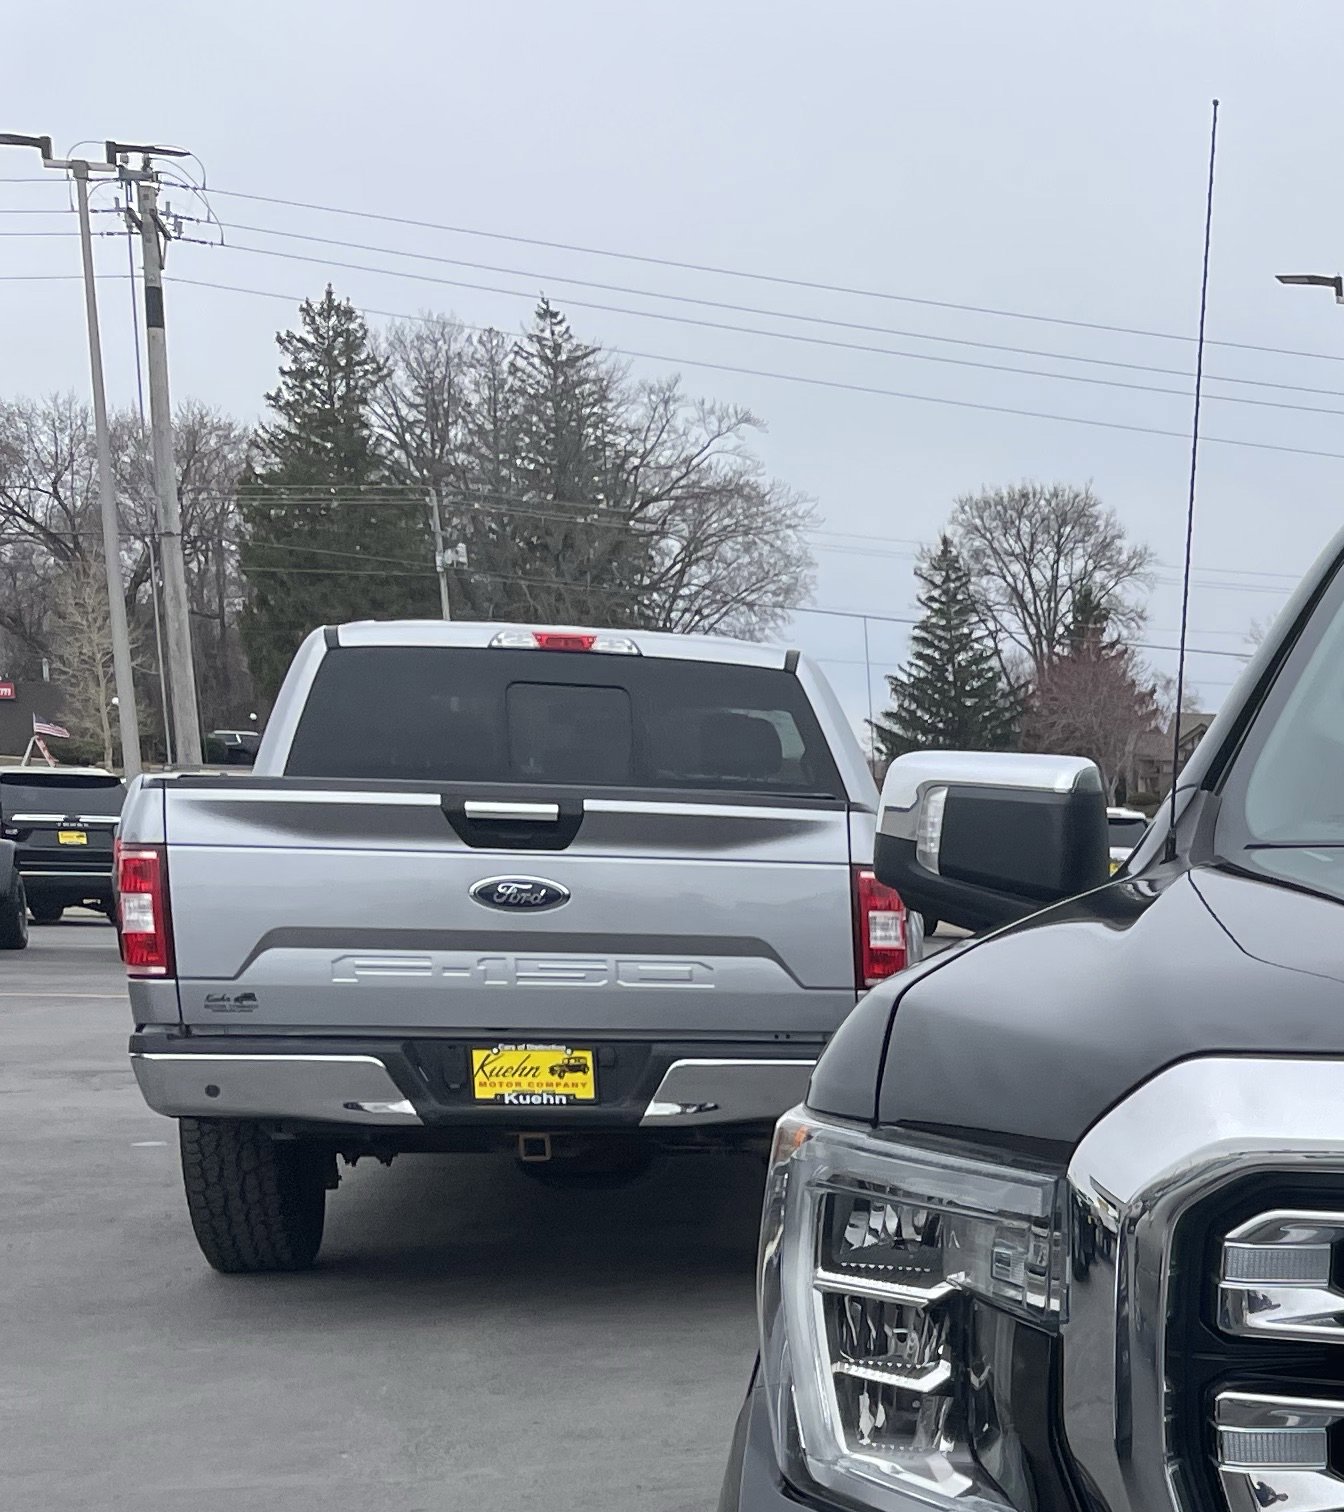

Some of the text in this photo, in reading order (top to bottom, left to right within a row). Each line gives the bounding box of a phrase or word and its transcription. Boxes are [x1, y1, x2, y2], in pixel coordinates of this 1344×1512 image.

[493, 882, 547, 905] Ford
[331, 954, 715, 988] F-150
[473, 1054, 541, 1081] Kuehn
[478, 1081, 588, 1089] MOTOR COMPANY
[504, 1092, 567, 1105] Kuehn
